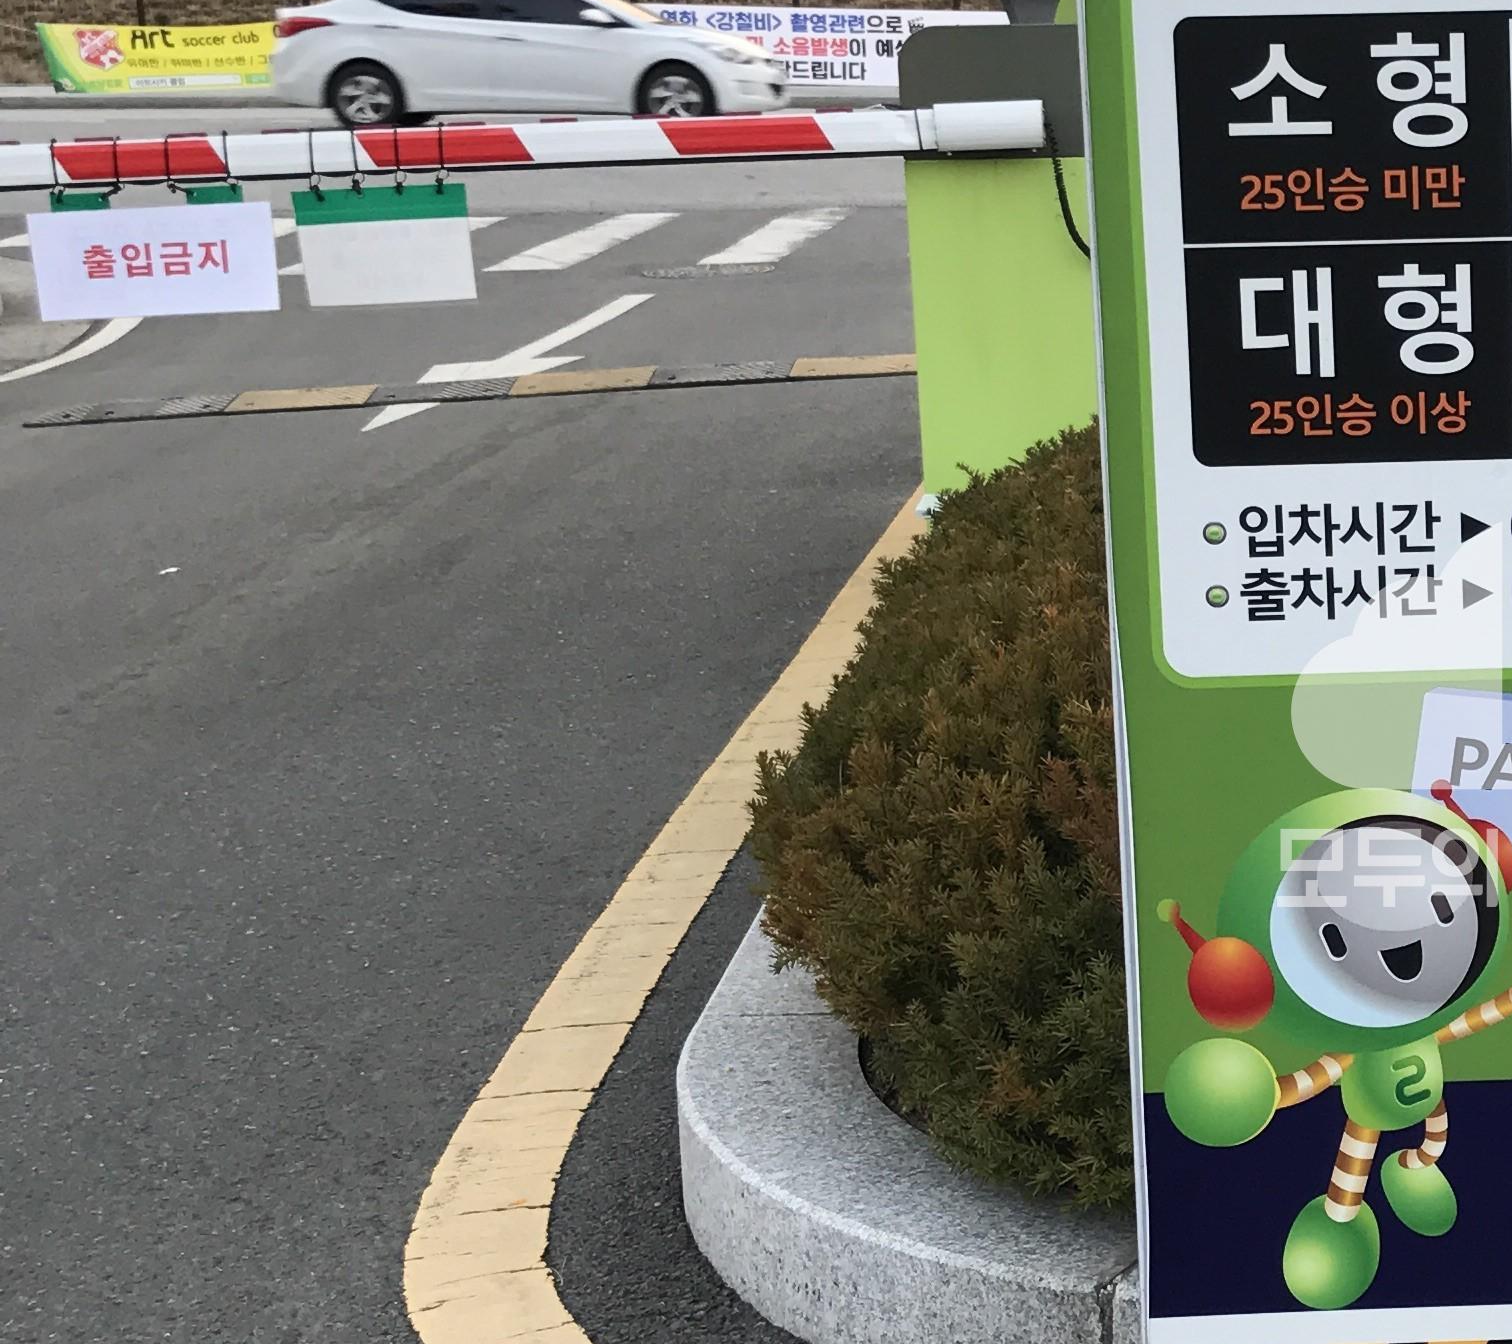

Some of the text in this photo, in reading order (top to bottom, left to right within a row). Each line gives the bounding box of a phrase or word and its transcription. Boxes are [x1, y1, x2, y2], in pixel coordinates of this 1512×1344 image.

[130, 28, 175, 50] Art
[182, 34, 226, 48] soccer
[232, 31, 260, 45] club
[1240, 165, 1466, 212] 25인승 미만
[82, 238, 230, 280] 출입금지
[1249, 391, 1472, 437] 25인승 이상
[1238, 501, 1441, 558] 입차시간
[1239, 564, 1443, 622] 출차시간
